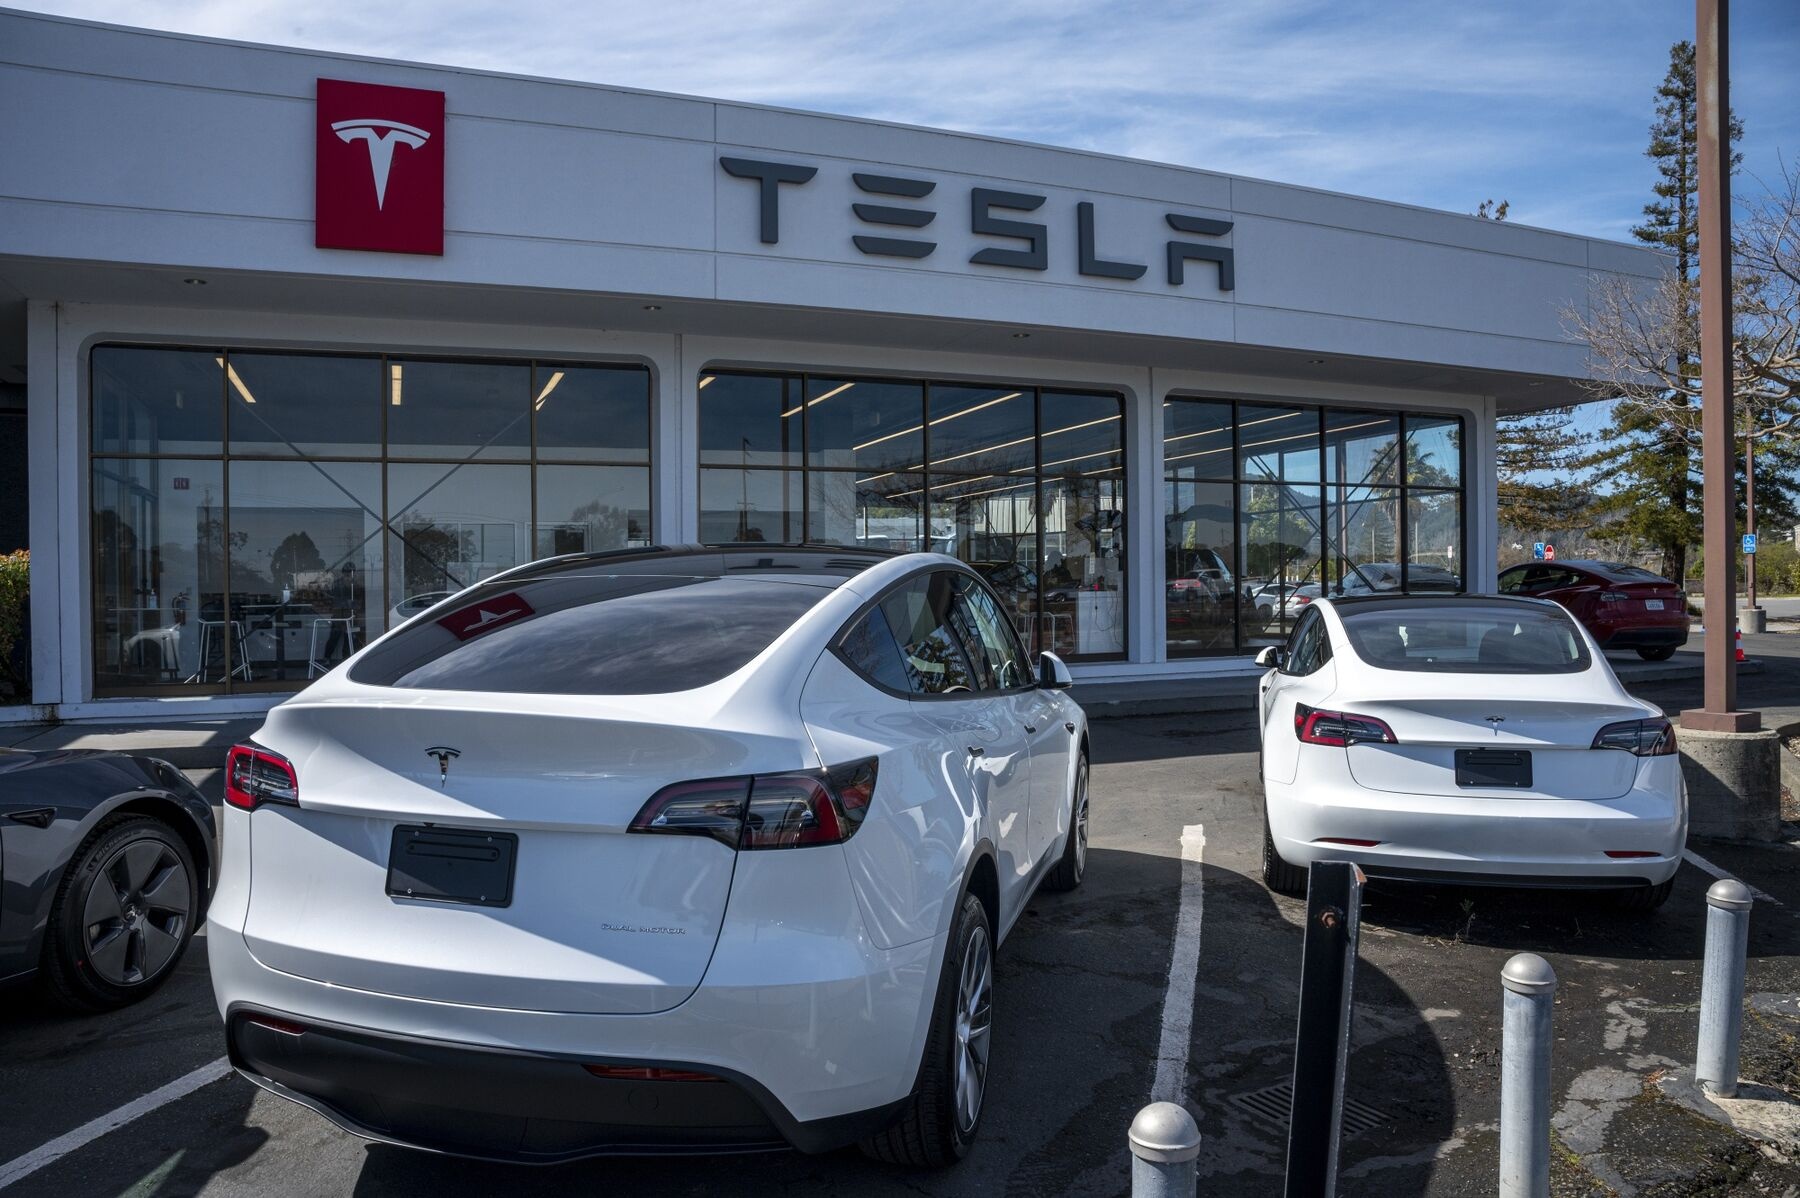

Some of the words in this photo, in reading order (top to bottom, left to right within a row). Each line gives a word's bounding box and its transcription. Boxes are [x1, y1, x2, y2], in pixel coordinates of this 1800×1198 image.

[719, 156, 1235, 291] TESLA
[601, 922, 636, 933] DUAL
[639, 926, 686, 935] MOTOR
